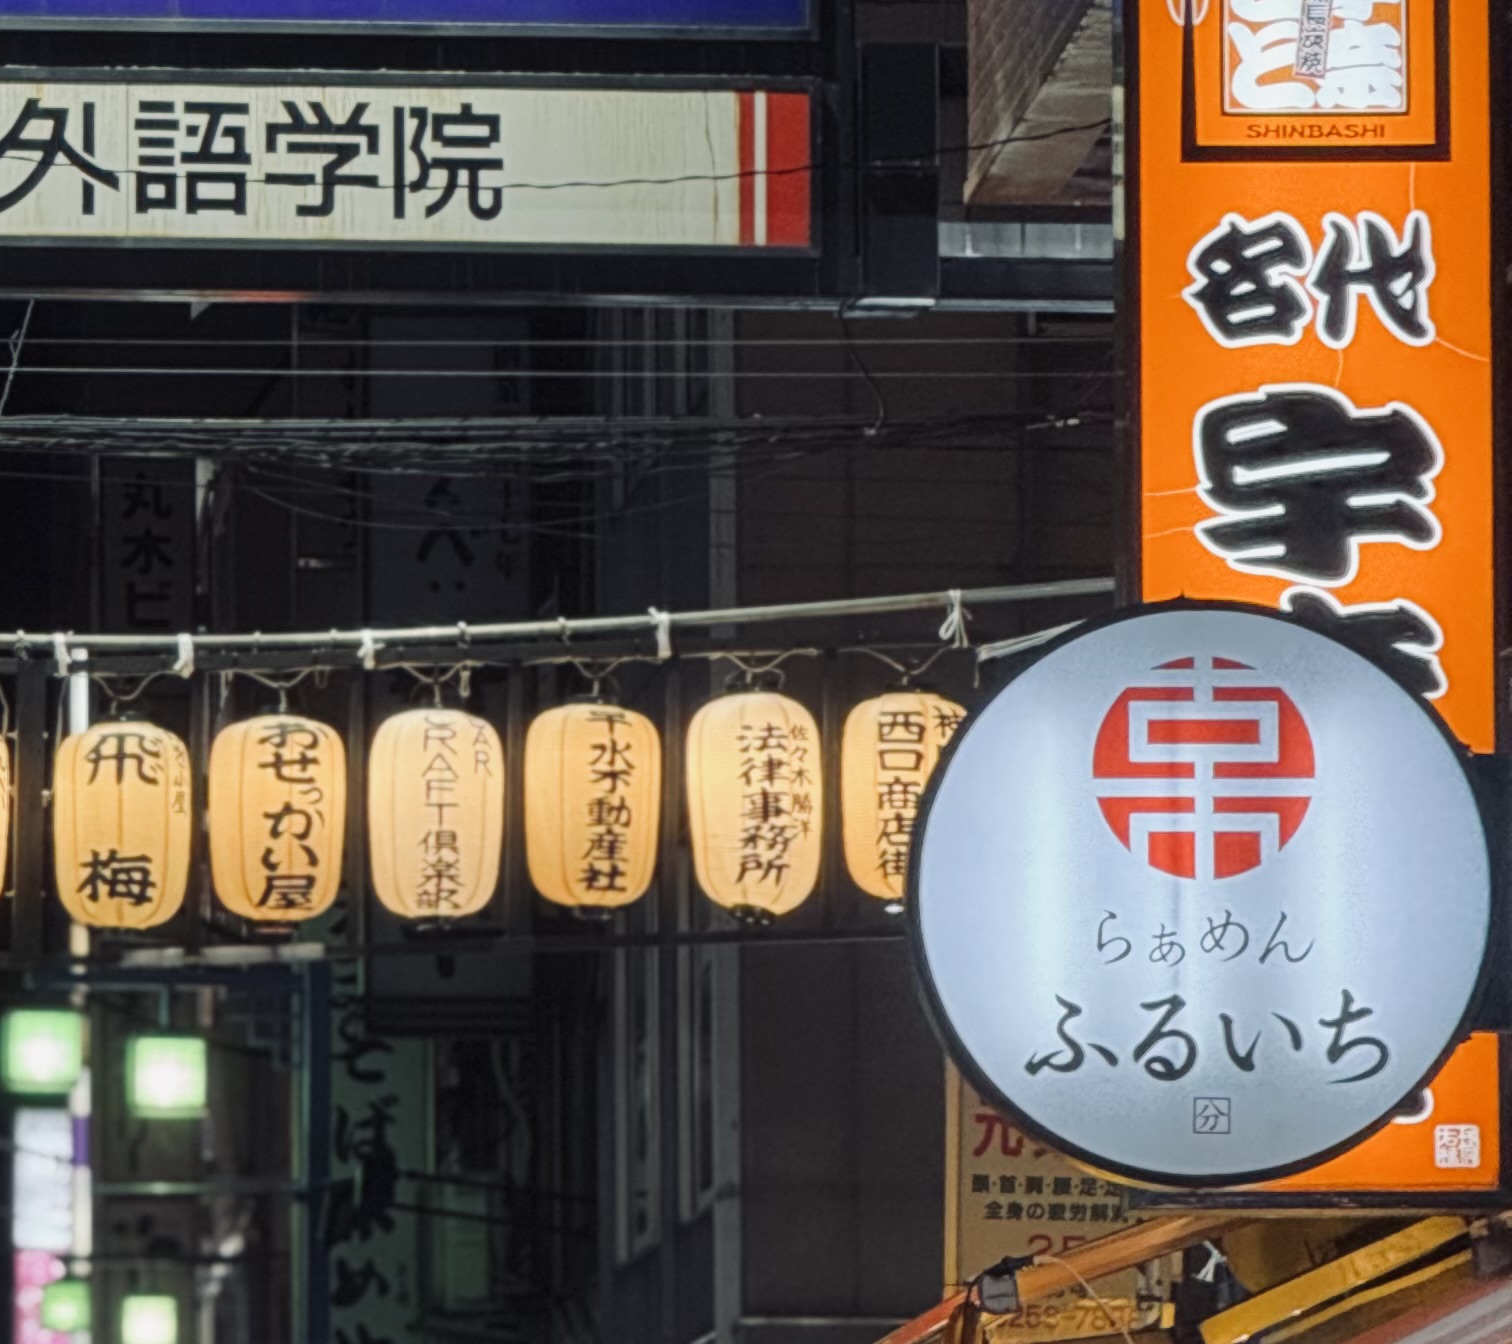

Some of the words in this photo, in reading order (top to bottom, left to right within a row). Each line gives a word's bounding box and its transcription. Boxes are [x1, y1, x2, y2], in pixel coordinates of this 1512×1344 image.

[1246, 124, 1386, 140] SHINBASHI
[76, 732, 163, 907] 飛梅
[736, 722, 797, 887] 法律事務所
[1096, 909, 1315, 967] らぁめん
[1024, 989, 1391, 1085] ふるいち
